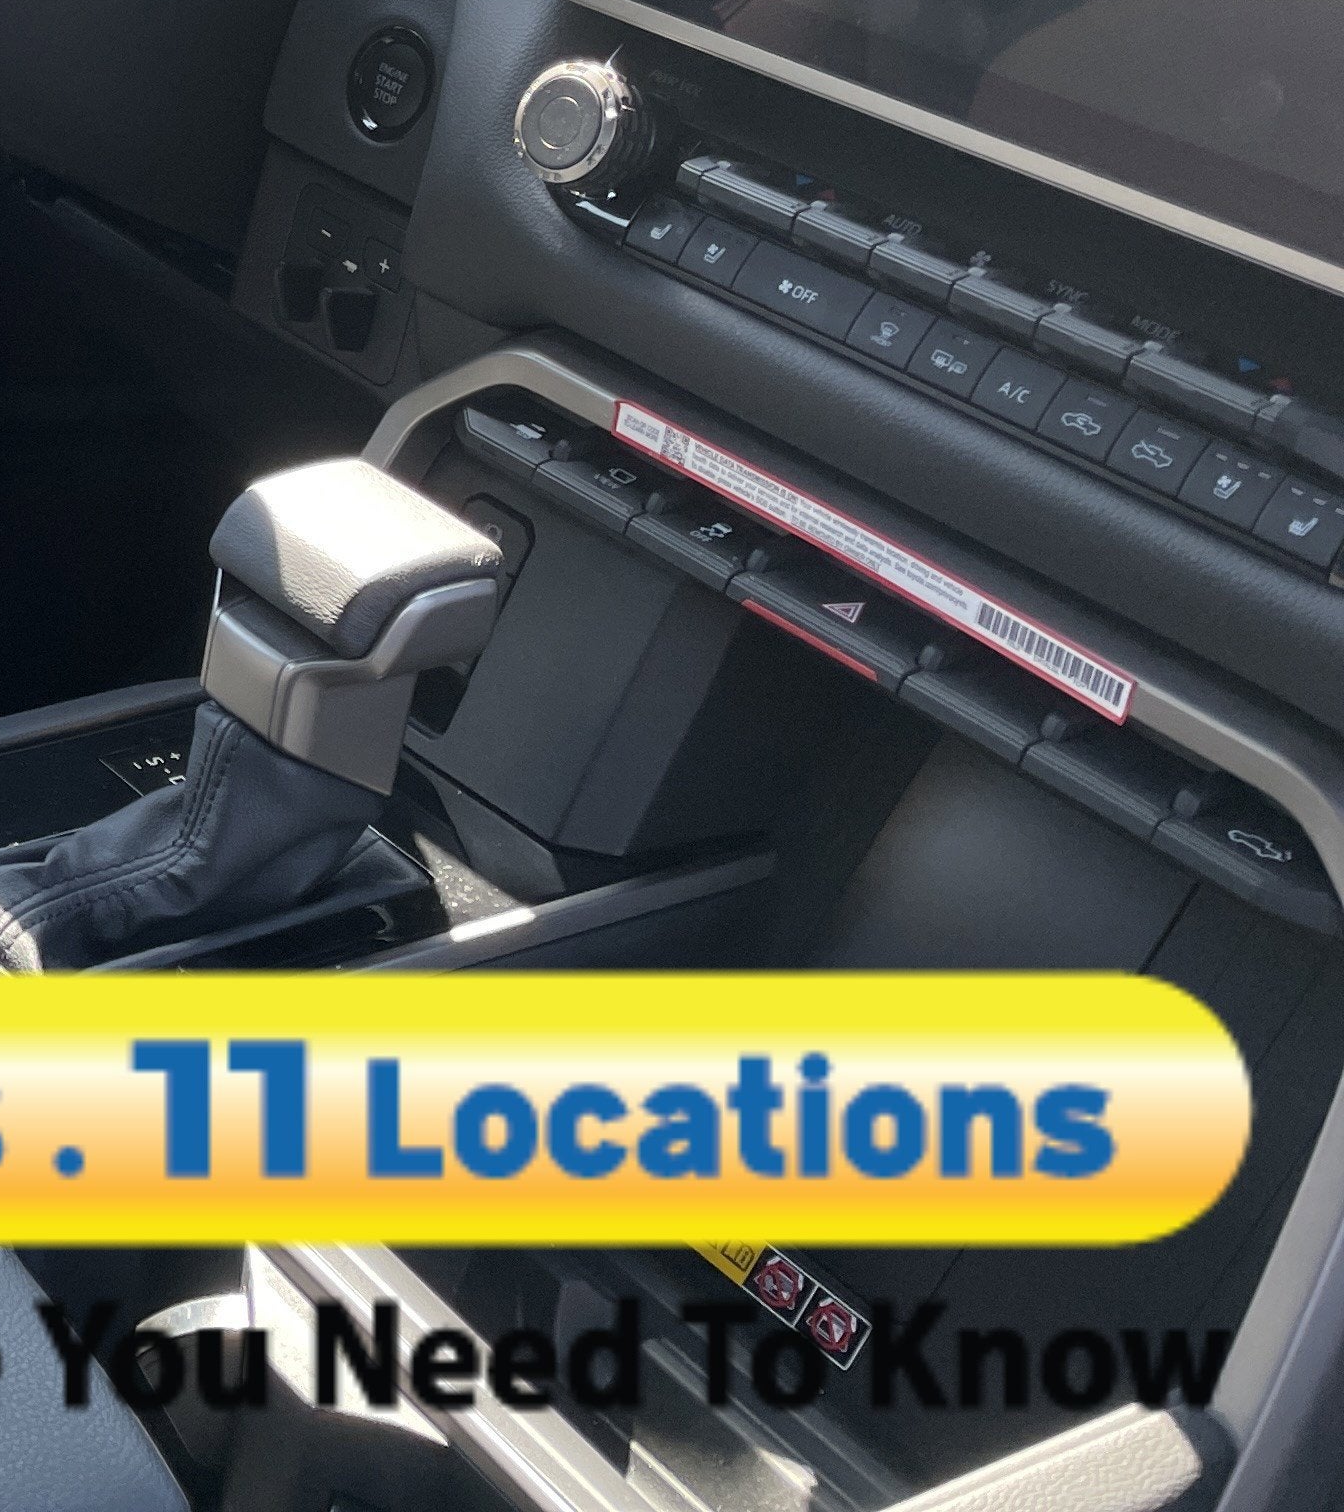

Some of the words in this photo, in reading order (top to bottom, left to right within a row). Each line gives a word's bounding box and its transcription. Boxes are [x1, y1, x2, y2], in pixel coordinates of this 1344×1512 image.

[375, 74, 404, 95] START
[373, 88, 397, 105] STOP
[882, 214, 922, 236] AUTO
[791, 285, 819, 303] OFF
[1048, 279, 1090, 303] SYNC
[1131, 315, 1182, 340] MODE
[997, 381, 1030, 404] A/C
